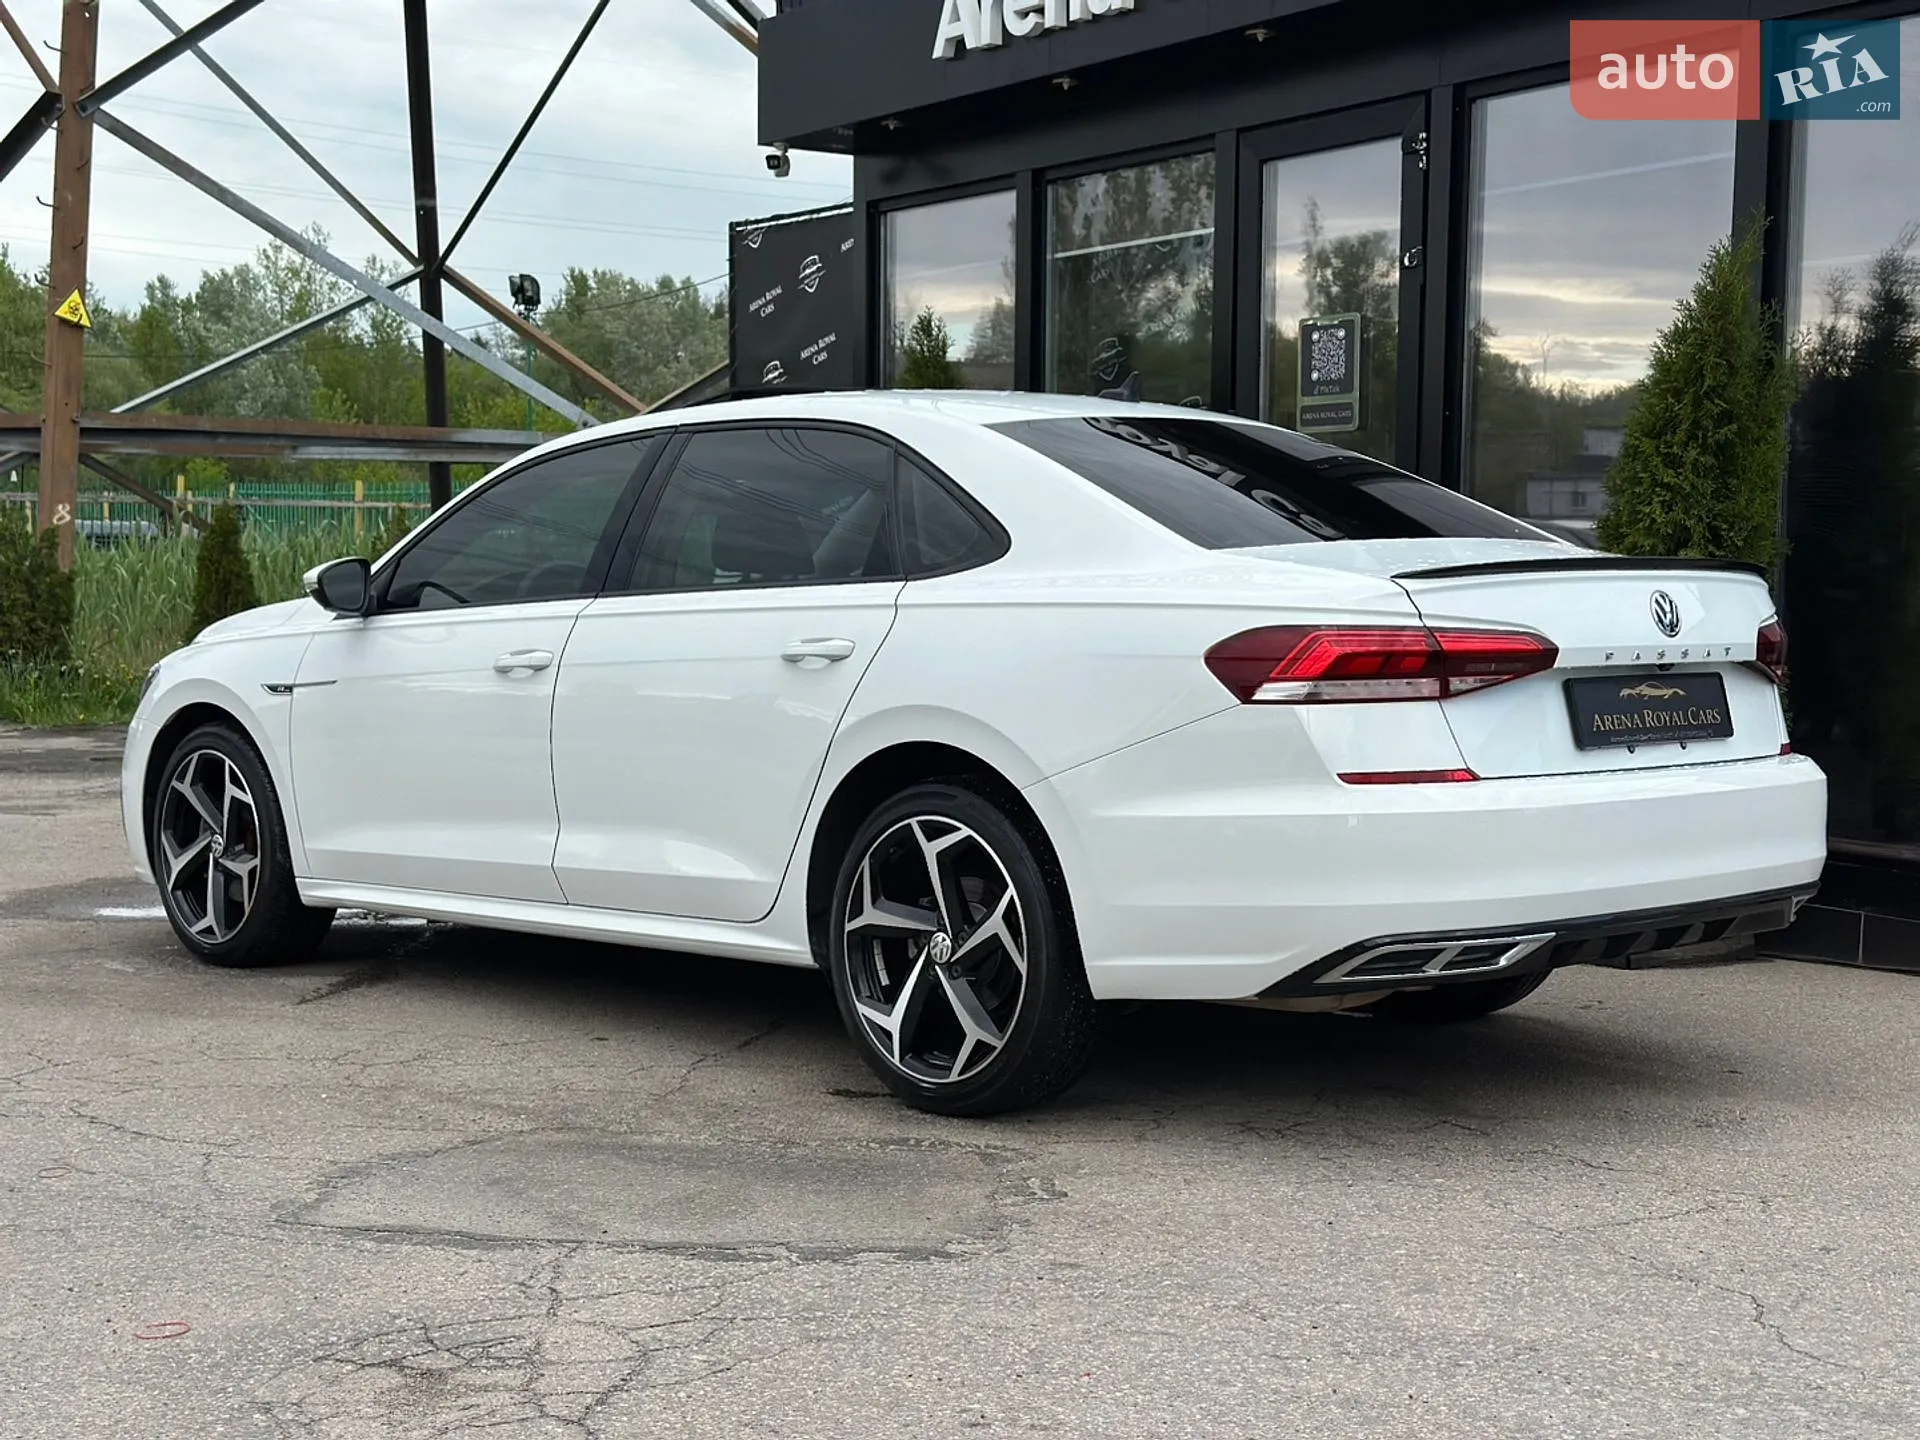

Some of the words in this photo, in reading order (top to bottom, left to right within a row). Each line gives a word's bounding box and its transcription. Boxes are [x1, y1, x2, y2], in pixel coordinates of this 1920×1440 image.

[52, 503, 71, 525] 8
[1593, 713, 1642, 732] ARENA
[1643, 709, 1688, 728] ROYAL
[1688, 706, 1721, 725] CARS
